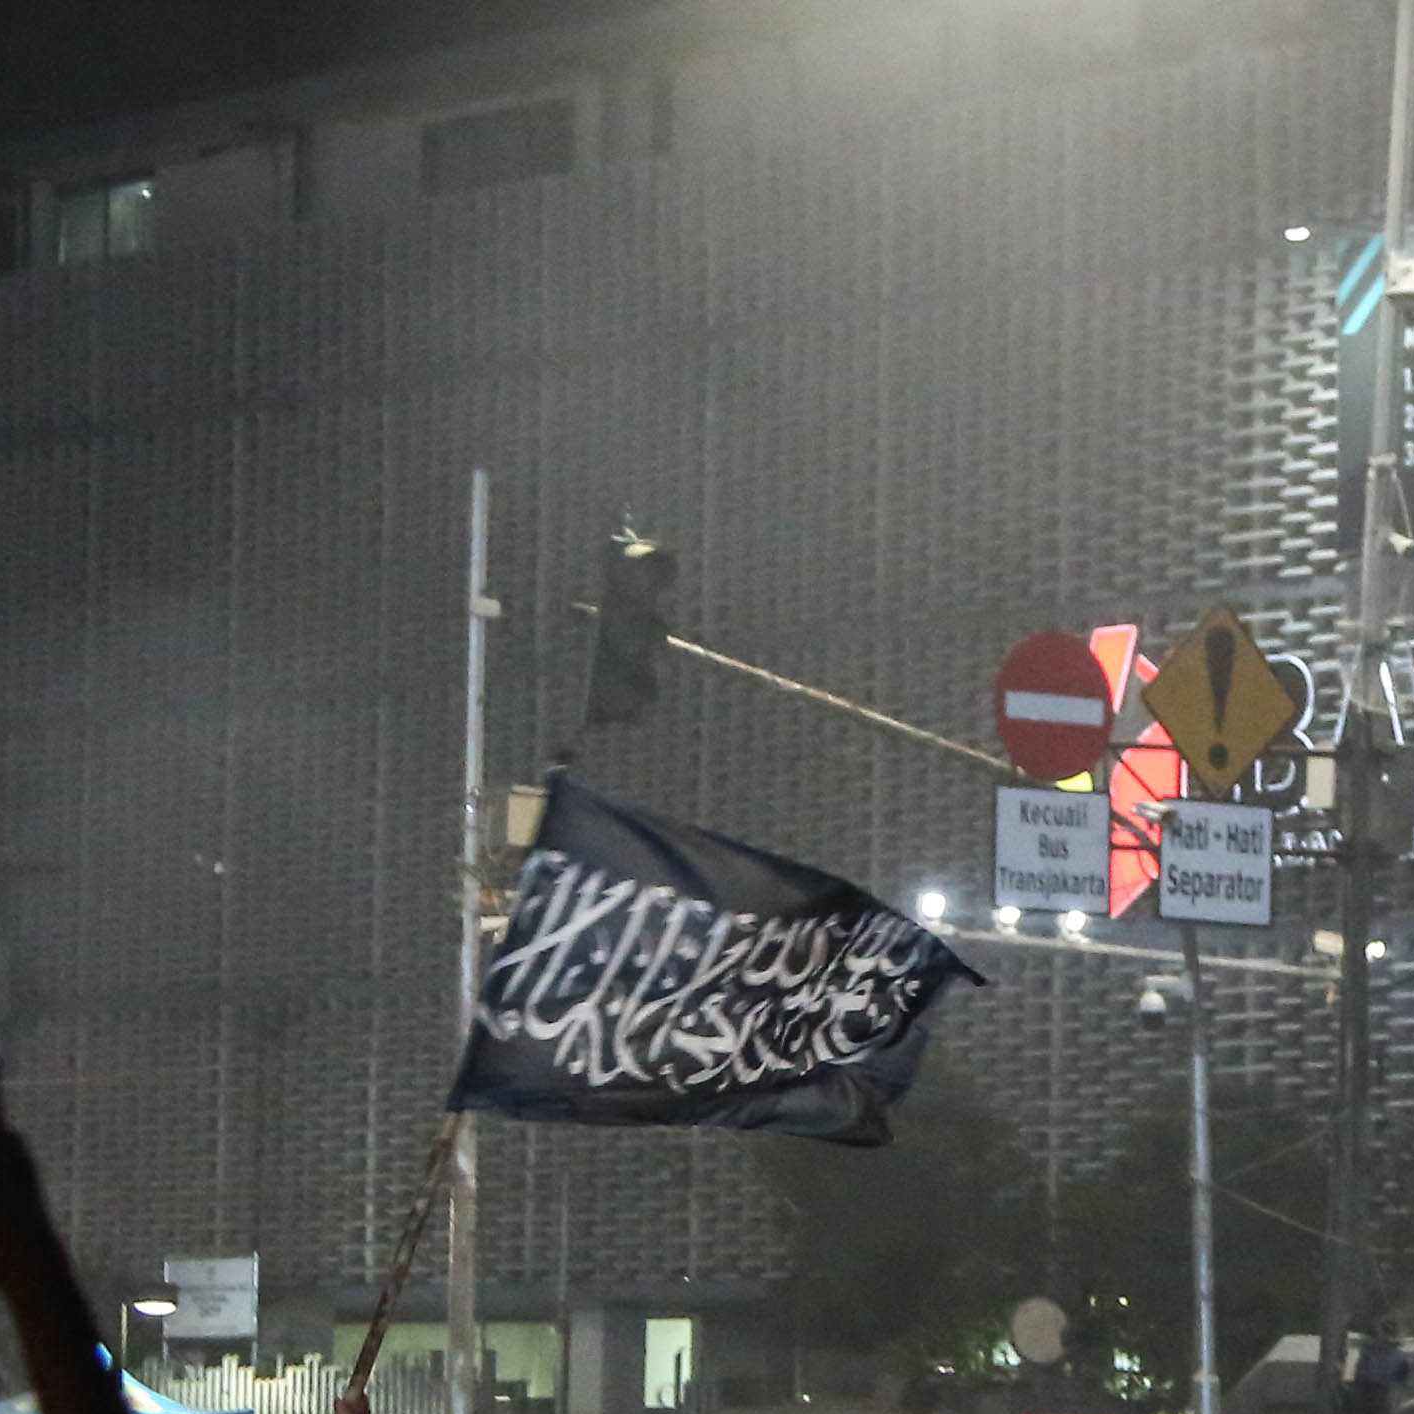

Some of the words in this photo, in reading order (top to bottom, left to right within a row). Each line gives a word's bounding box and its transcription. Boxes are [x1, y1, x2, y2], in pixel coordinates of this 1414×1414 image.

[1019, 800, 1087, 827] Kecuali
[1038, 833, 1070, 859] Bus
[1226, 821, 1264, 855] Hati
[999, 866, 1105, 901] Transjakarta
[1167, 864, 1264, 906] Separator
